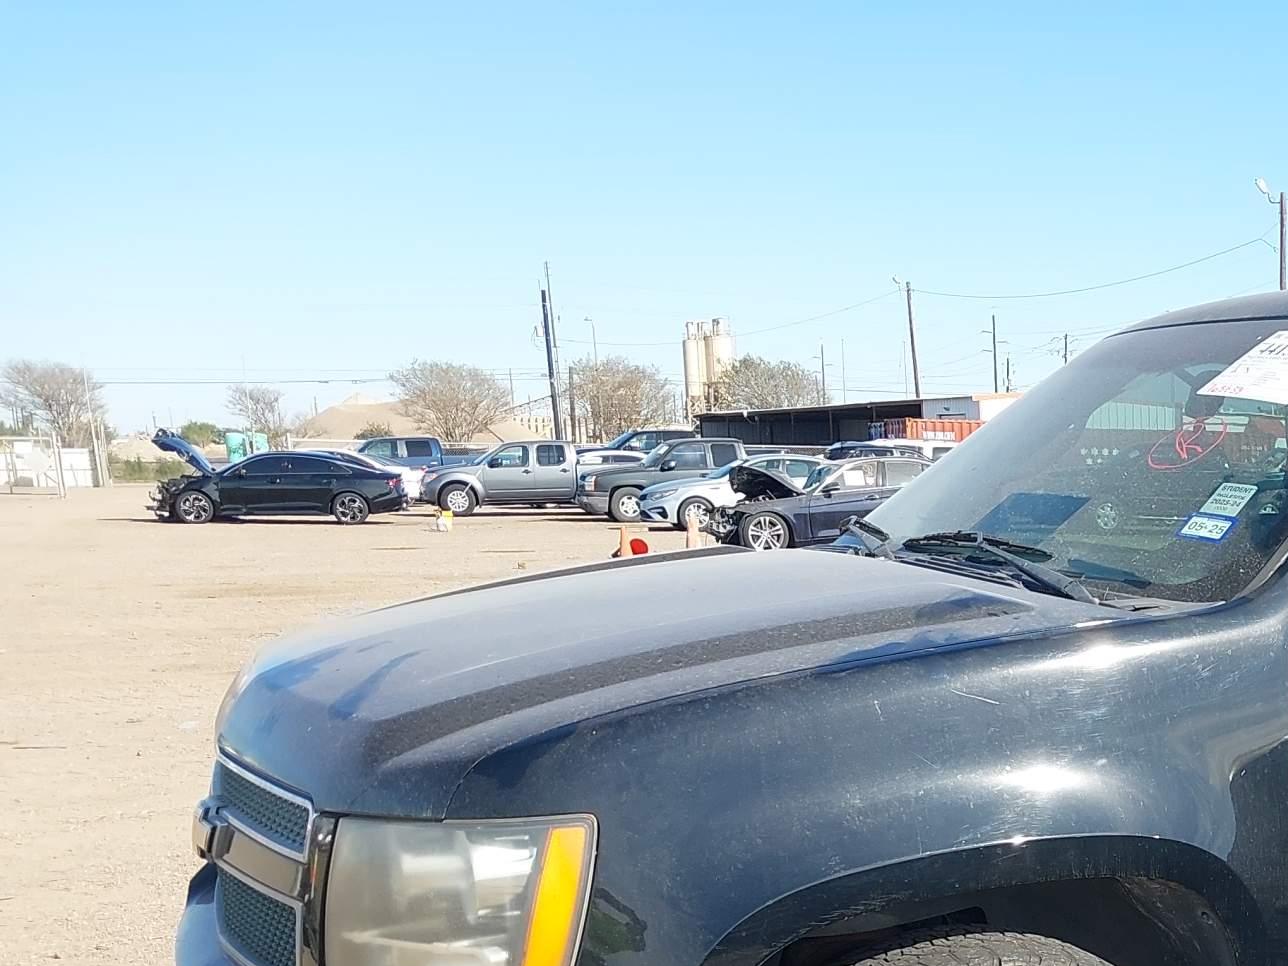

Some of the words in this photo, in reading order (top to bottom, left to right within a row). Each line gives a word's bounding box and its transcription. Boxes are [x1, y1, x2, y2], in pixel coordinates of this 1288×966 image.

[1221, 484, 1254, 495] STUDENT
[1187, 521, 1205, 531] 05
[1207, 524, 1227, 534] 25
